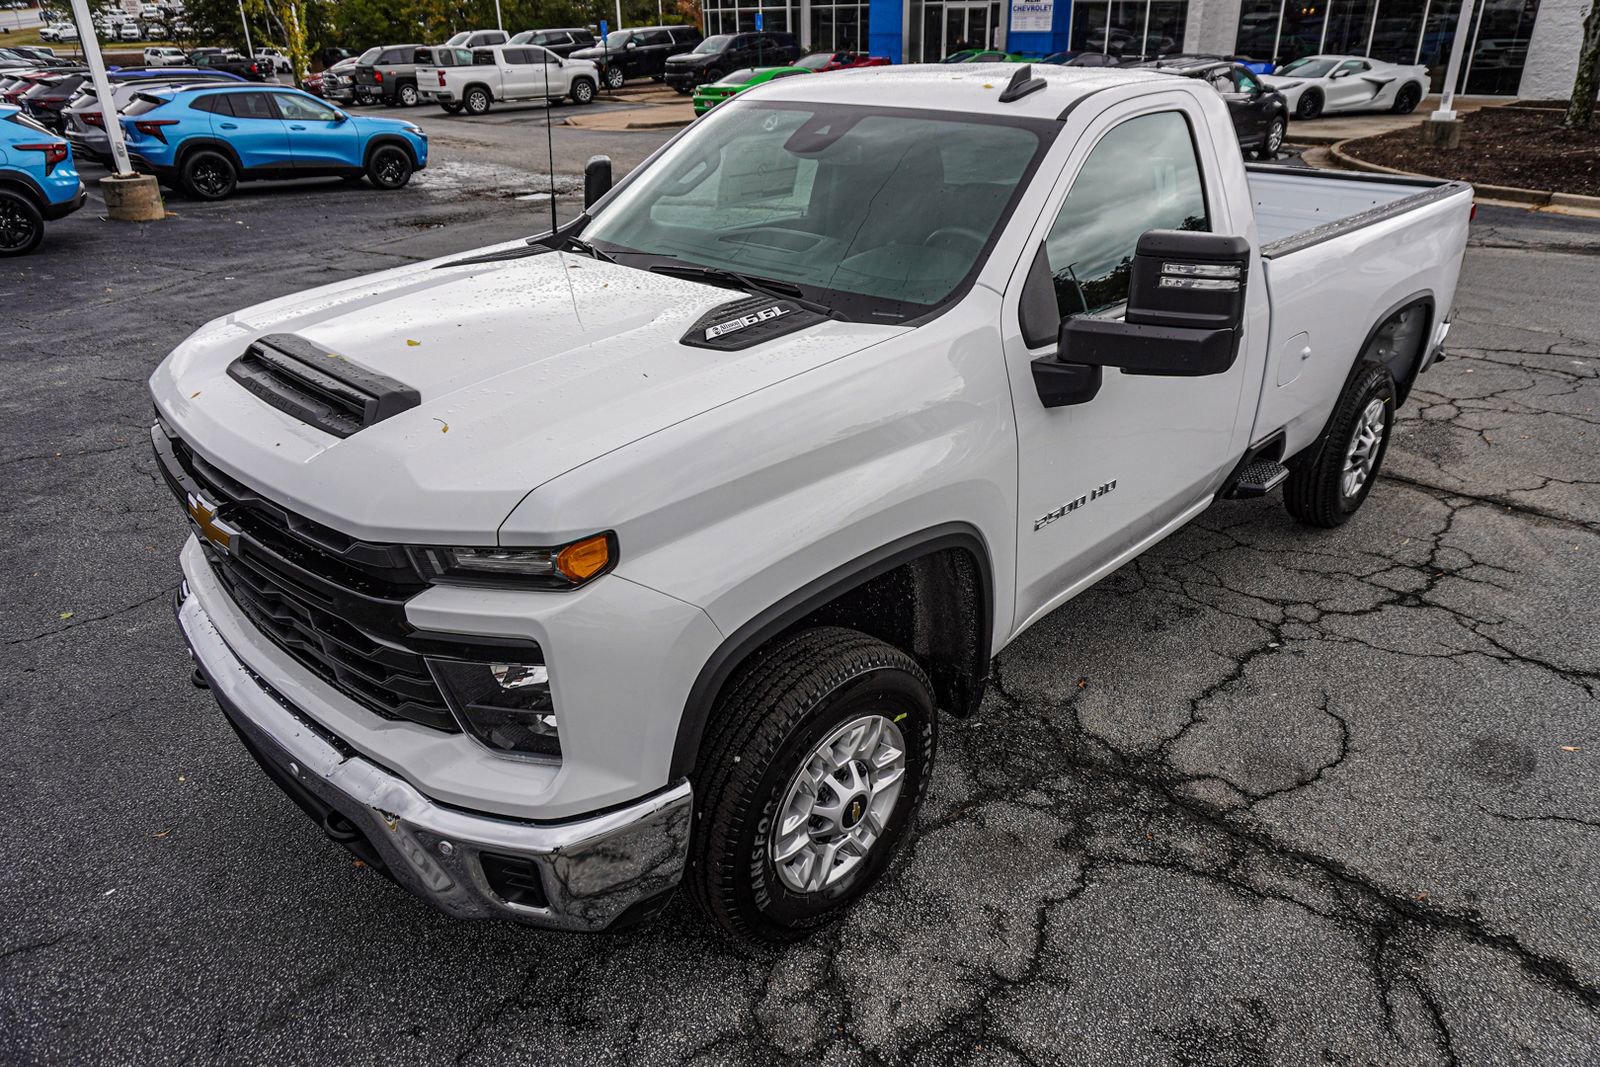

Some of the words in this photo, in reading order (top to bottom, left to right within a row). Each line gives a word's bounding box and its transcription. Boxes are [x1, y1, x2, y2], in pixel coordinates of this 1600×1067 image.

[741, 306, 790, 327] 6.6L
[1034, 495, 1087, 532] 2500
[1090, 479, 1116, 501] HD
